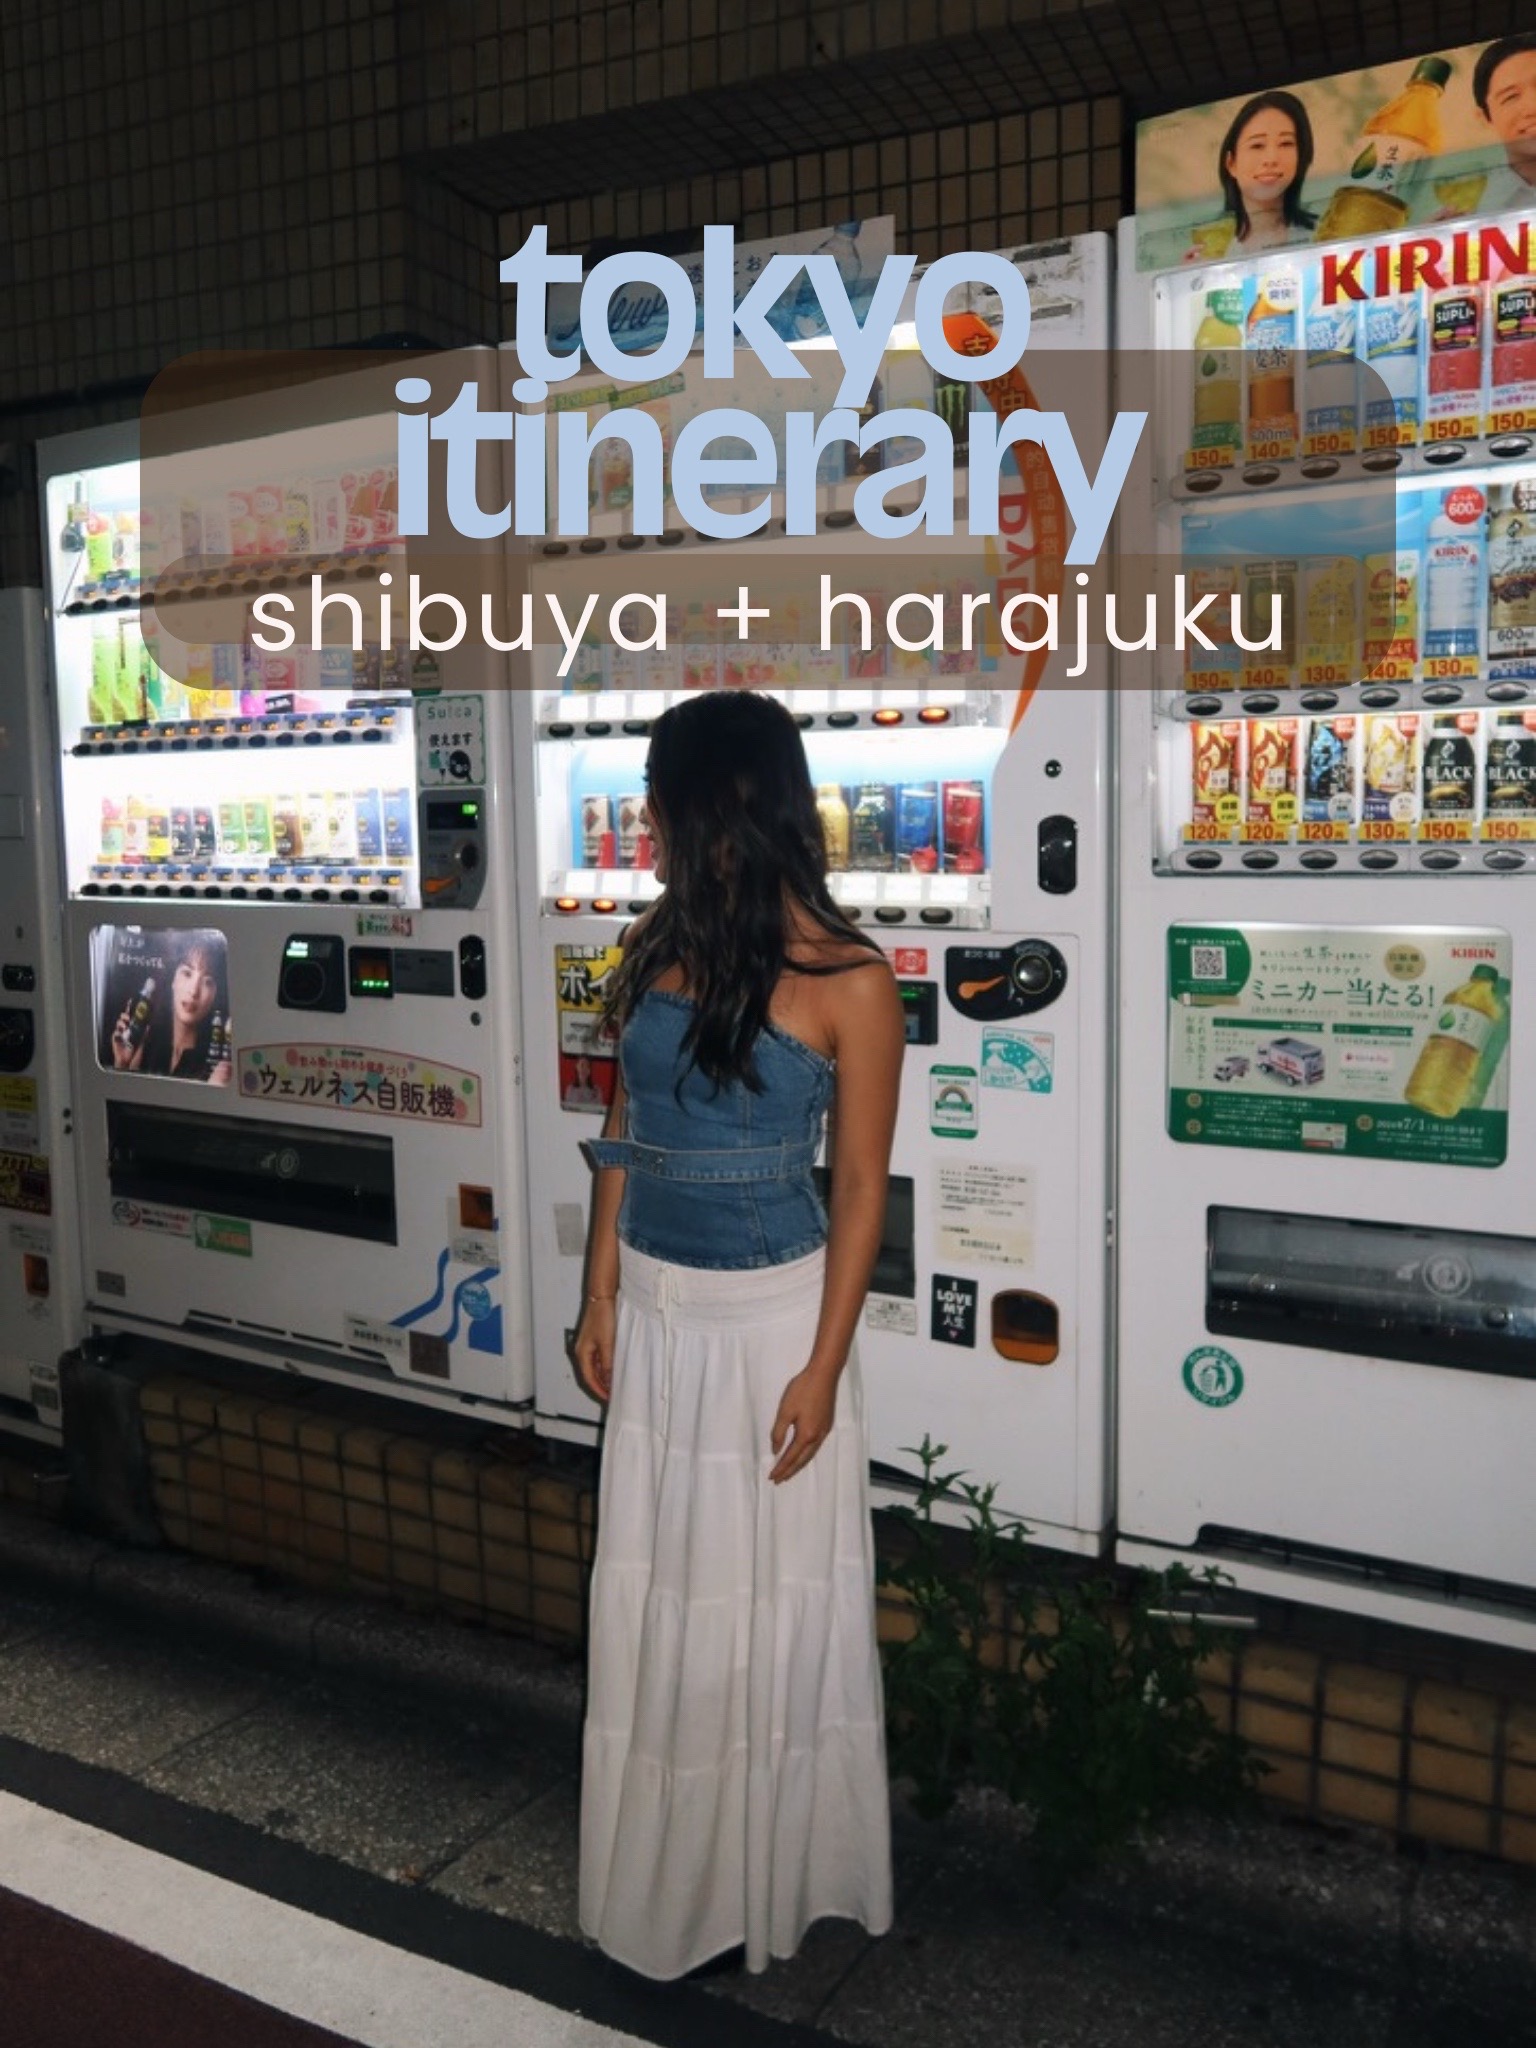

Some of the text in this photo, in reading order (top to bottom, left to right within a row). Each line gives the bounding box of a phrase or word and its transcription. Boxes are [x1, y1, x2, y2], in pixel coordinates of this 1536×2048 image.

[1322, 221, 1530, 306] KIRIN
[428, 708, 472, 719] Suica
[1425, 765, 1473, 780] BLACK
[1451, 947, 1496, 959] KIRIN
[1253, 978, 1435, 1008] ミニカー当たる!
[258, 1063, 456, 1118] ウェルネス自販機
[951, 1281, 958, 1292] I
[936, 1288, 973, 1306] LOVE
[943, 1303, 966, 1316] MY
